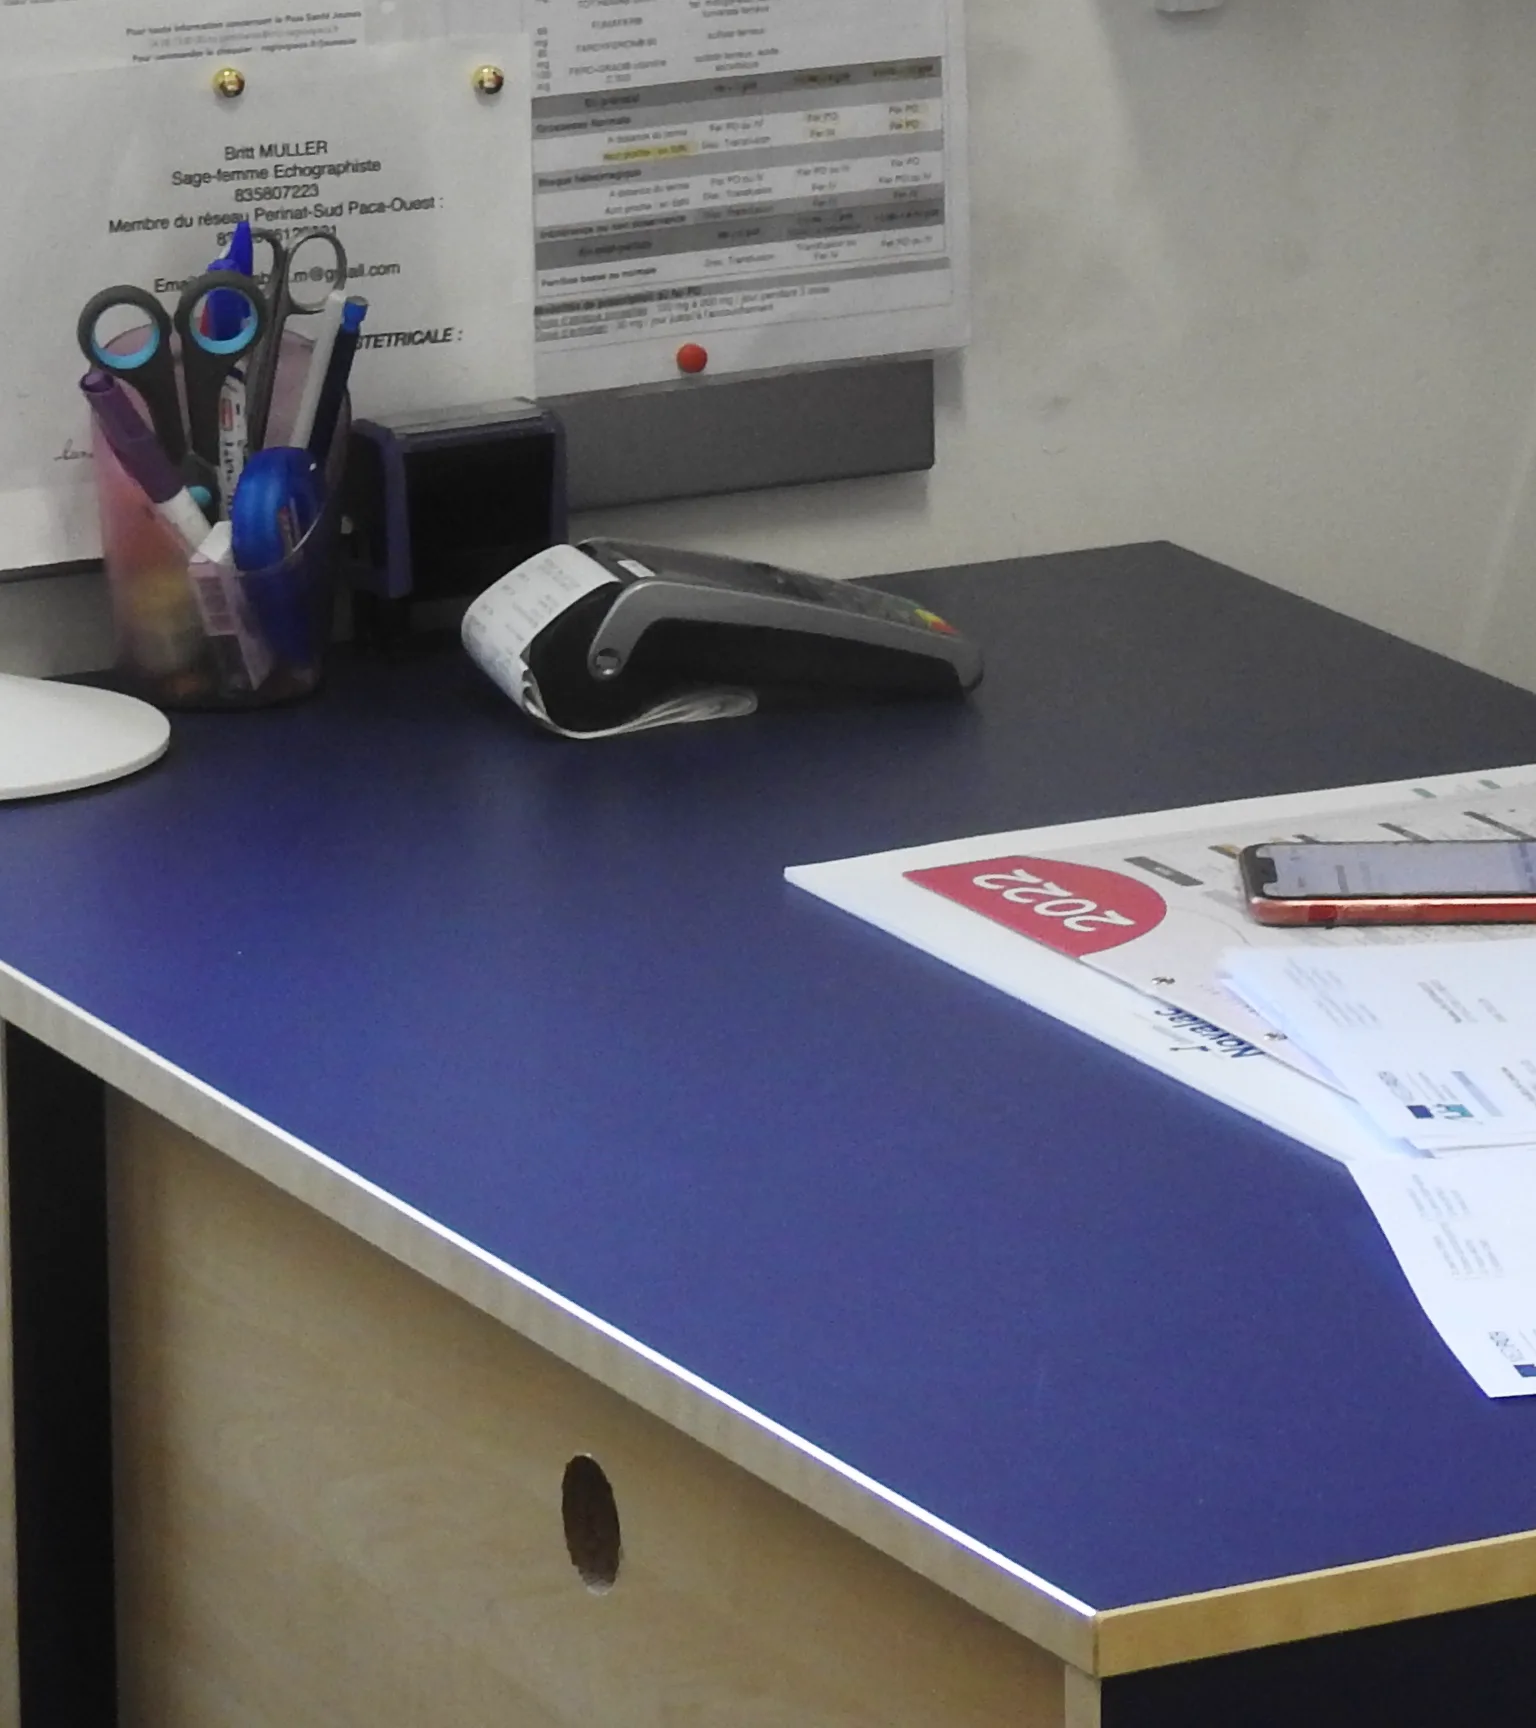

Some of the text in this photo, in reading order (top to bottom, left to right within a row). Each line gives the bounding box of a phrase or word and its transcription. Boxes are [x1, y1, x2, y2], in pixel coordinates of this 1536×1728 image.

[225, 140, 328, 162] Britt MULLER
[171, 158, 382, 189] Sage-femme Echographiste
[234, 183, 319, 203] 835807223
[108, 218, 171, 234] Membre
[173, 213, 194, 229] du
[197, 209, 250, 227] réseau
[354, 327, 454, 351] STETRICALE
[973, 869, 1136, 932] 2022
